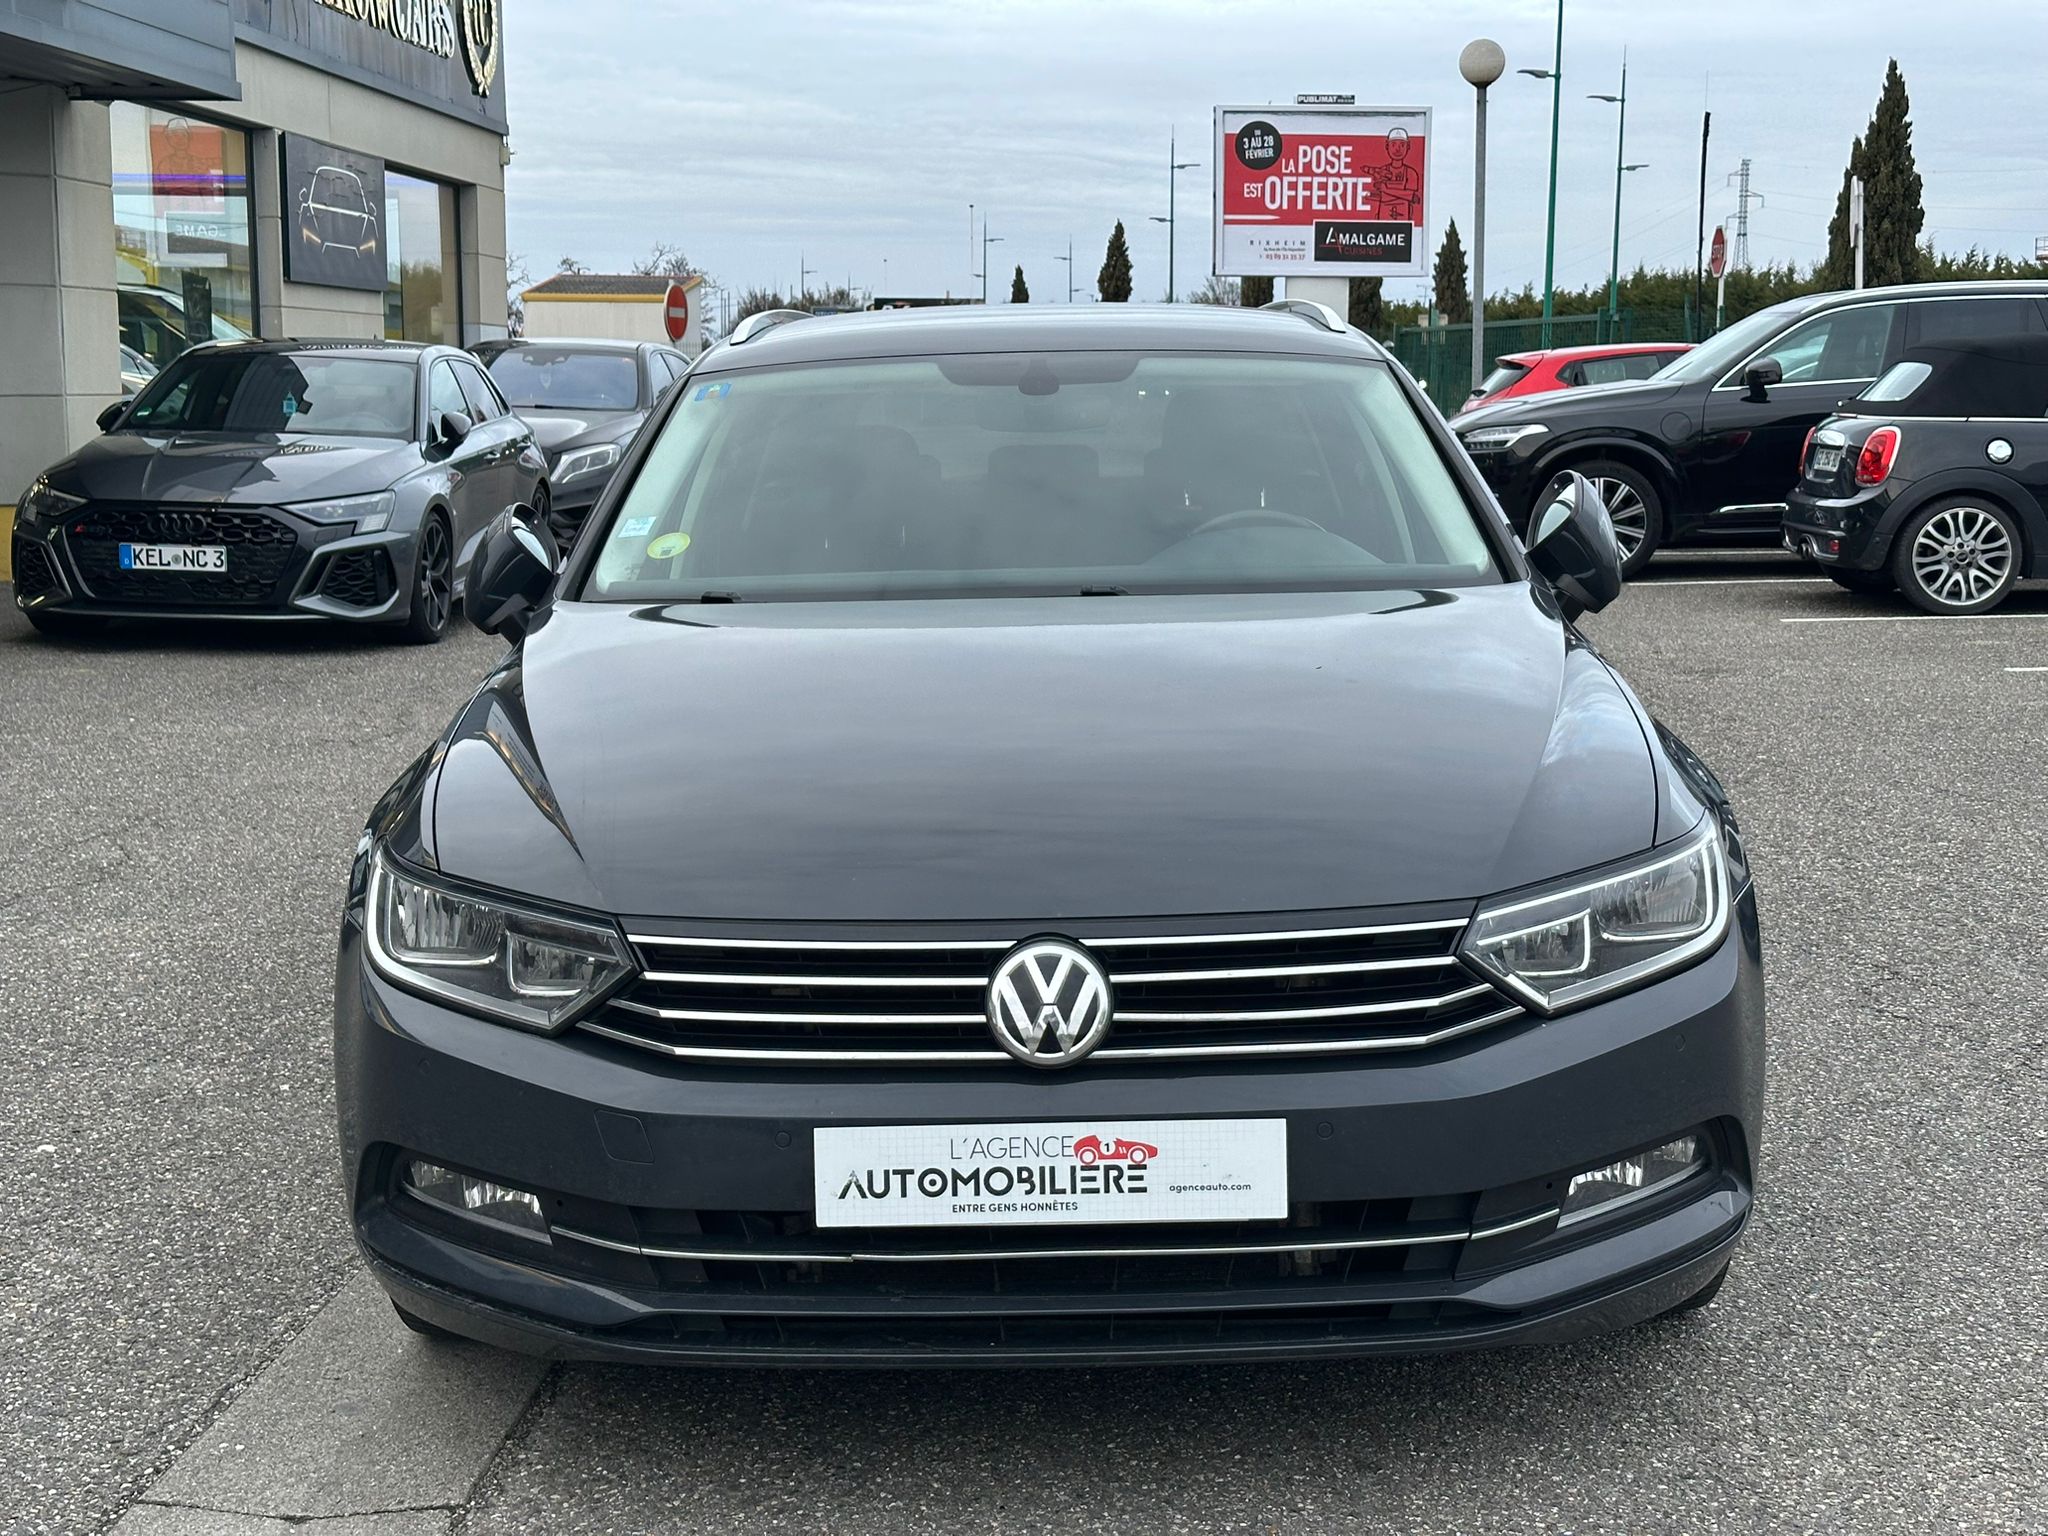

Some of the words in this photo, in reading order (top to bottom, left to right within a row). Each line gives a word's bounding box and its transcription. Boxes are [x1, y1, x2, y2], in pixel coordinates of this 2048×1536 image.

[1298, 95, 1337, 103] PUBLIMAT
[1243, 138, 1249, 149] 3
[1250, 137, 1262, 148] AU
[1263, 135, 1274, 147] 28
[1282, 159, 1295, 173] LA
[1298, 145, 1352, 174] POSE
[1244, 183, 1263, 198] EST
[1264, 175, 1371, 211] OFFERTE
[132, 548, 171, 567] KEL
[182, 550, 208, 568] NC
[213, 551, 224, 568] 3
[1169, 1183, 1252, 1194] agenceauto.com
[952, 1204, 986, 1213] ENTRE
[988, 1203, 1018, 1212] GENS
[1020, 1199, 1079, 1212] HONNÊTES
